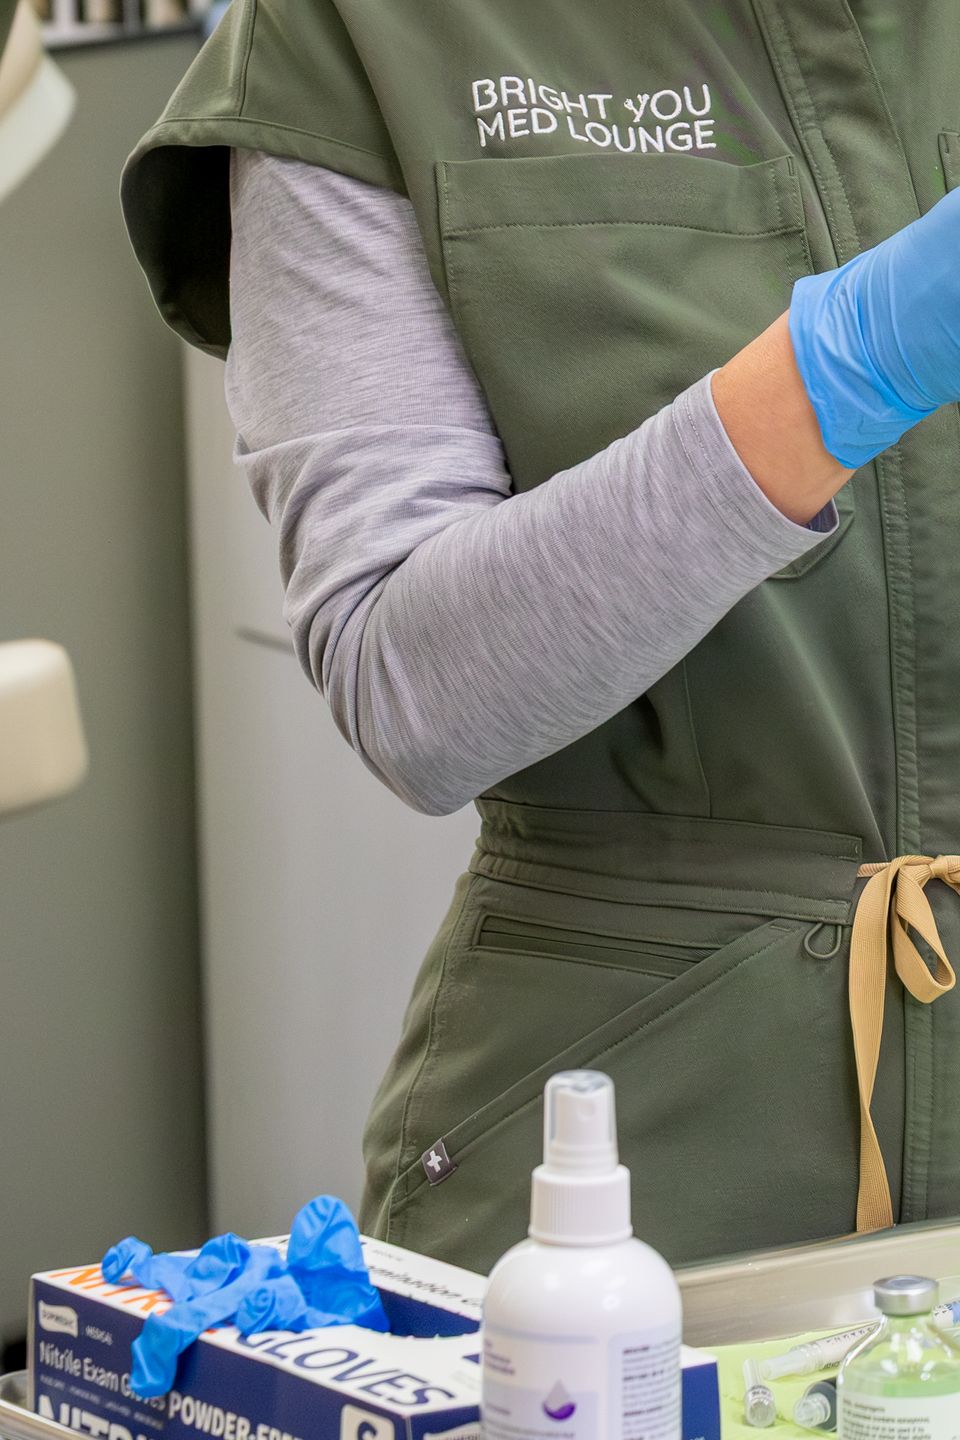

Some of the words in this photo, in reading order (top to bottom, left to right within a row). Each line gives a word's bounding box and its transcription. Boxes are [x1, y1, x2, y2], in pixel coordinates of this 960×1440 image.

[471, 76, 612, 120] BRIGHT
[623, 83, 712, 123] YOU
[476, 107, 558, 148] MED
[566, 115, 717, 153] LOUNGE
[39, 1341, 82, 1377] Nitrile
[83, 1357, 119, 1393] Exam
[121, 1372, 166, 1411] Ges
[167, 1390, 304, 1440] POWDER-F
